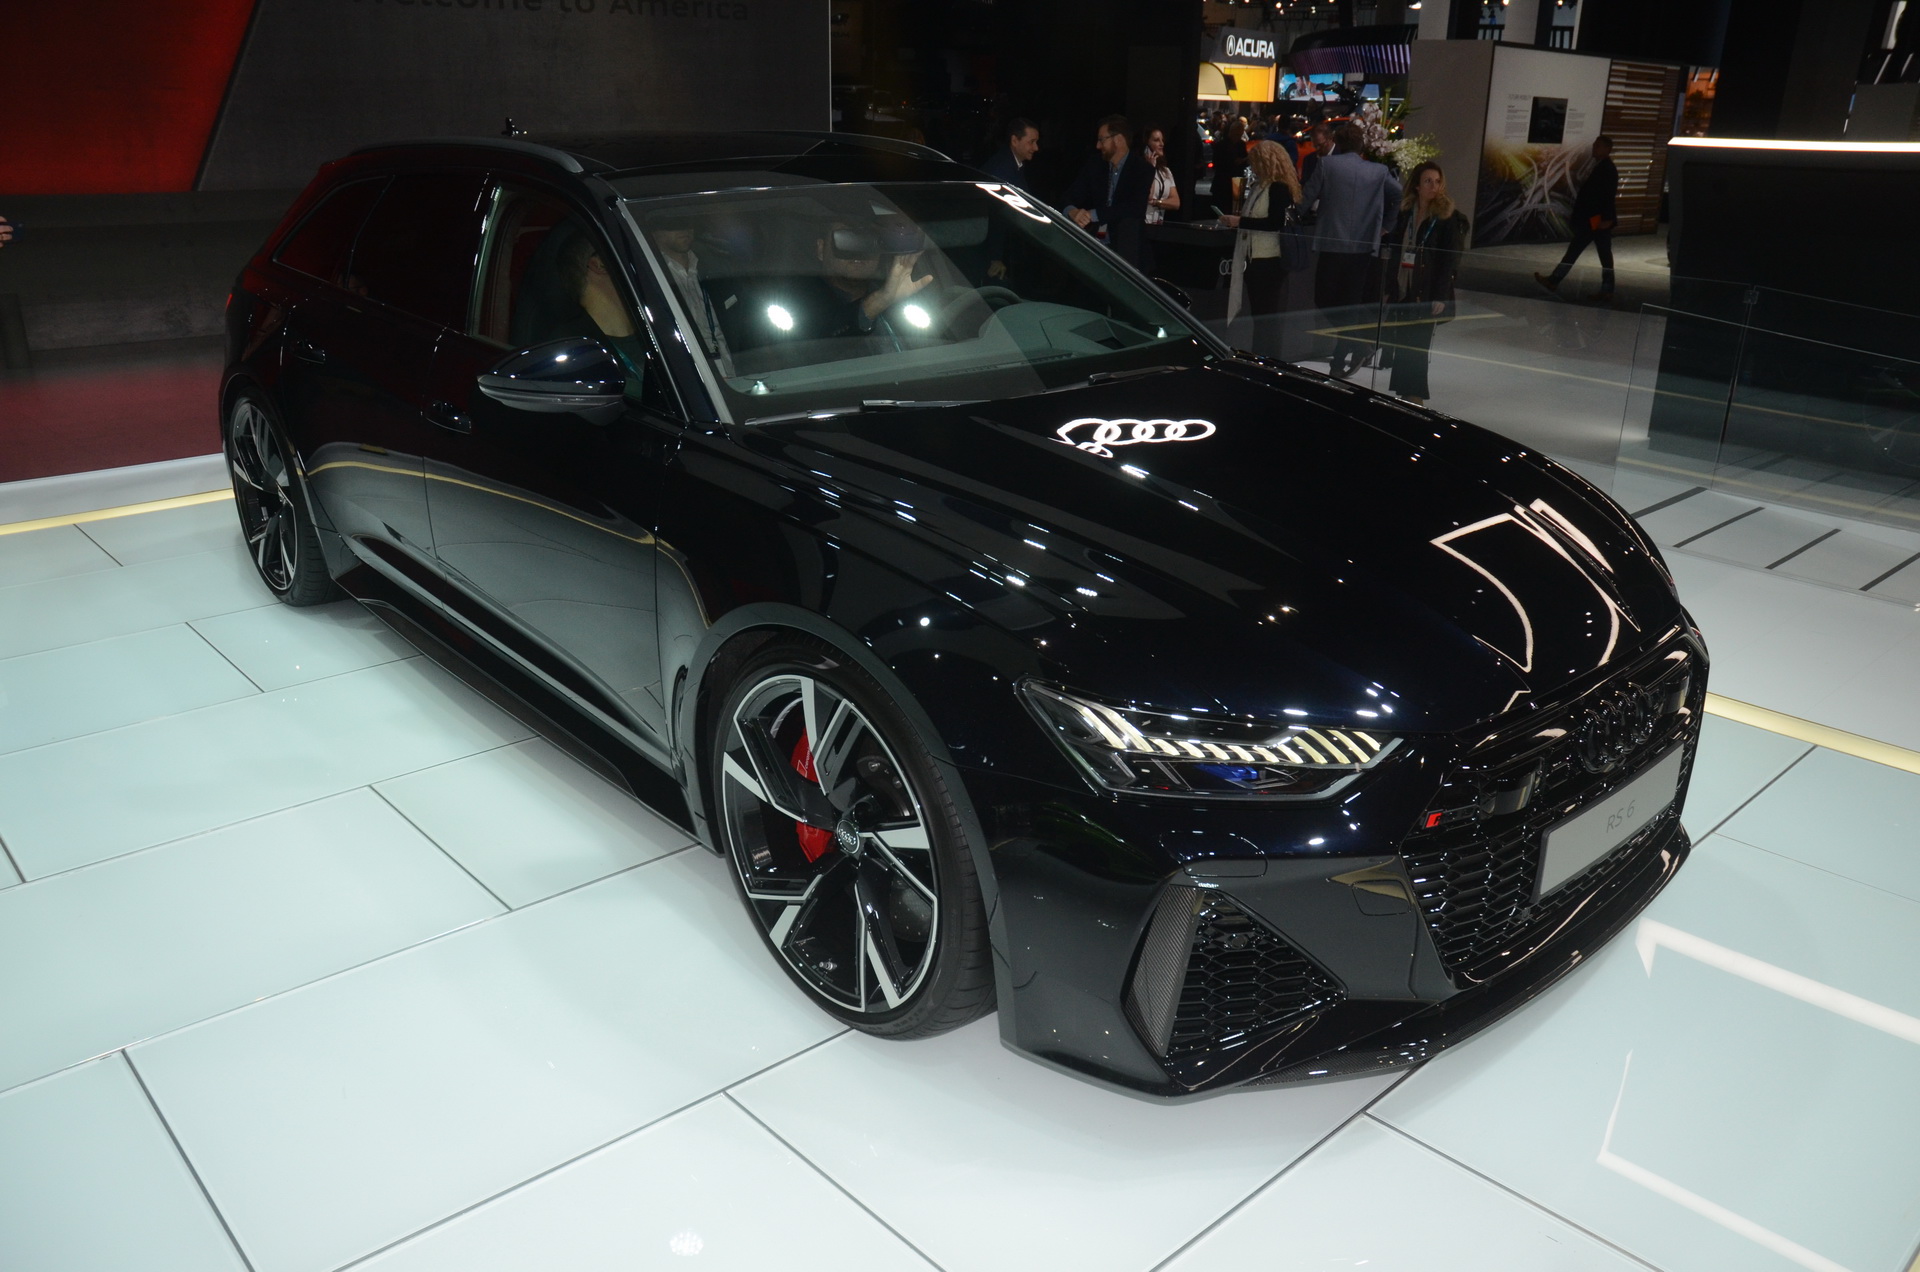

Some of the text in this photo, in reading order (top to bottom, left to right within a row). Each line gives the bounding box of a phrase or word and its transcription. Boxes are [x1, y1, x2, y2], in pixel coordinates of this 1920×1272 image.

[609, 0, 748, 21] America
[1234, 37, 1275, 59] ACURA
[1606, 800, 1636, 833] RS 6
